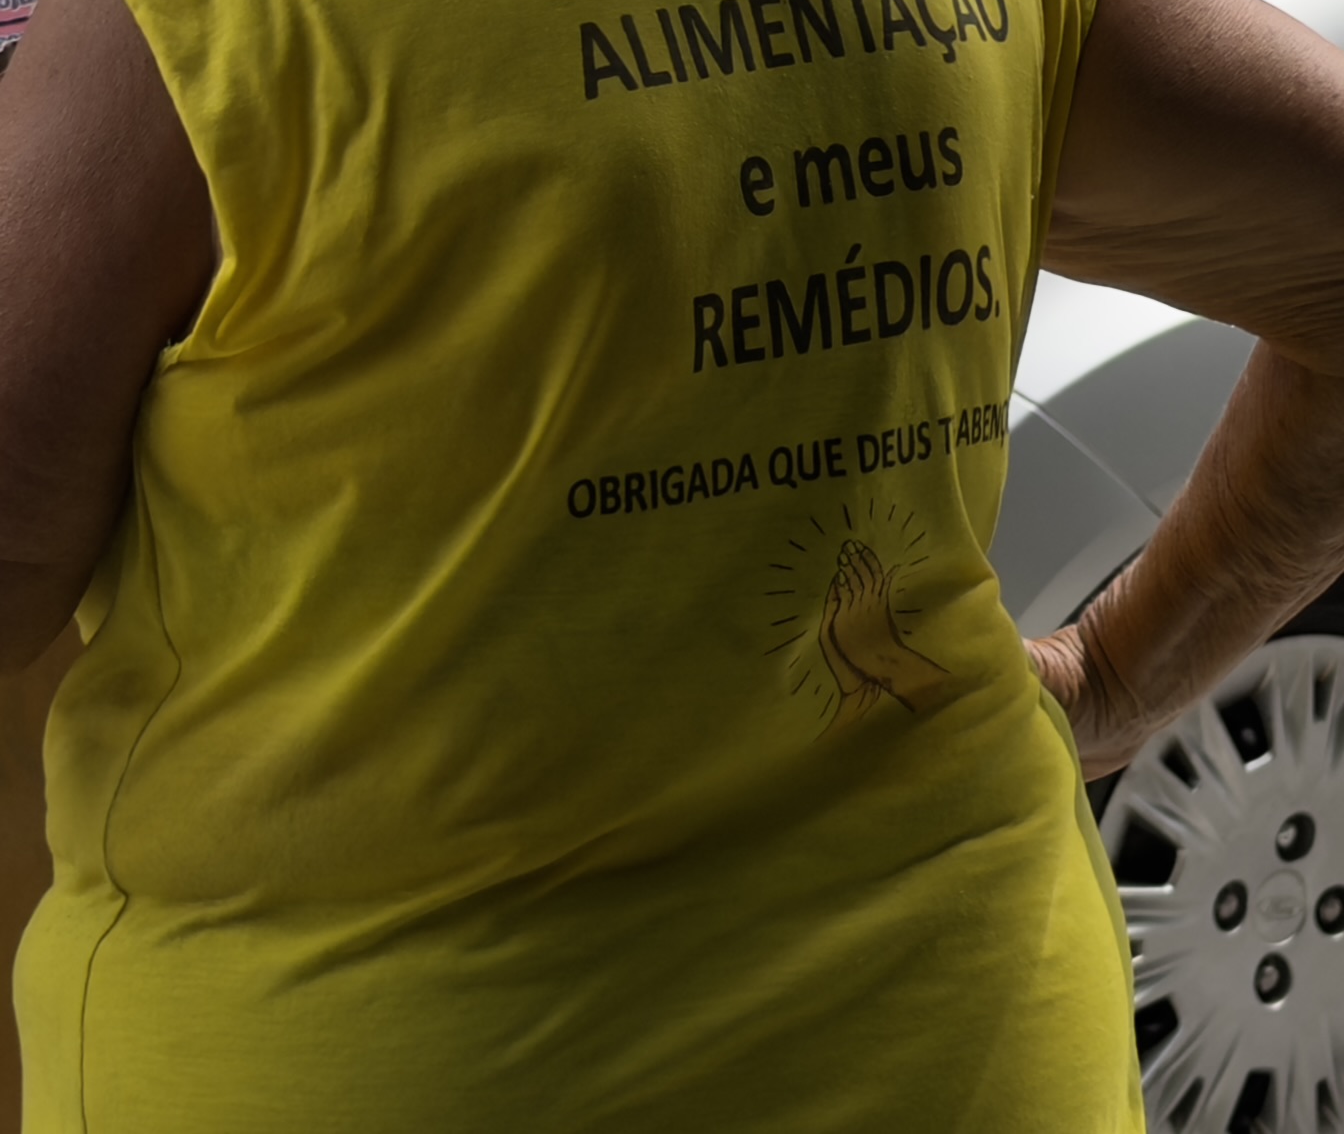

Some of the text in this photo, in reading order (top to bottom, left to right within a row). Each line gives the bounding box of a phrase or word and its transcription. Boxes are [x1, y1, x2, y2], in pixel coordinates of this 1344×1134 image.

[739, 126, 964, 217] e meus
[692, 243, 1002, 374] REMÉDIOS.
[566, 453, 760, 519] OBRIGADA
[768, 437, 848, 490] QUE
[856, 420, 932, 475] DEUS
